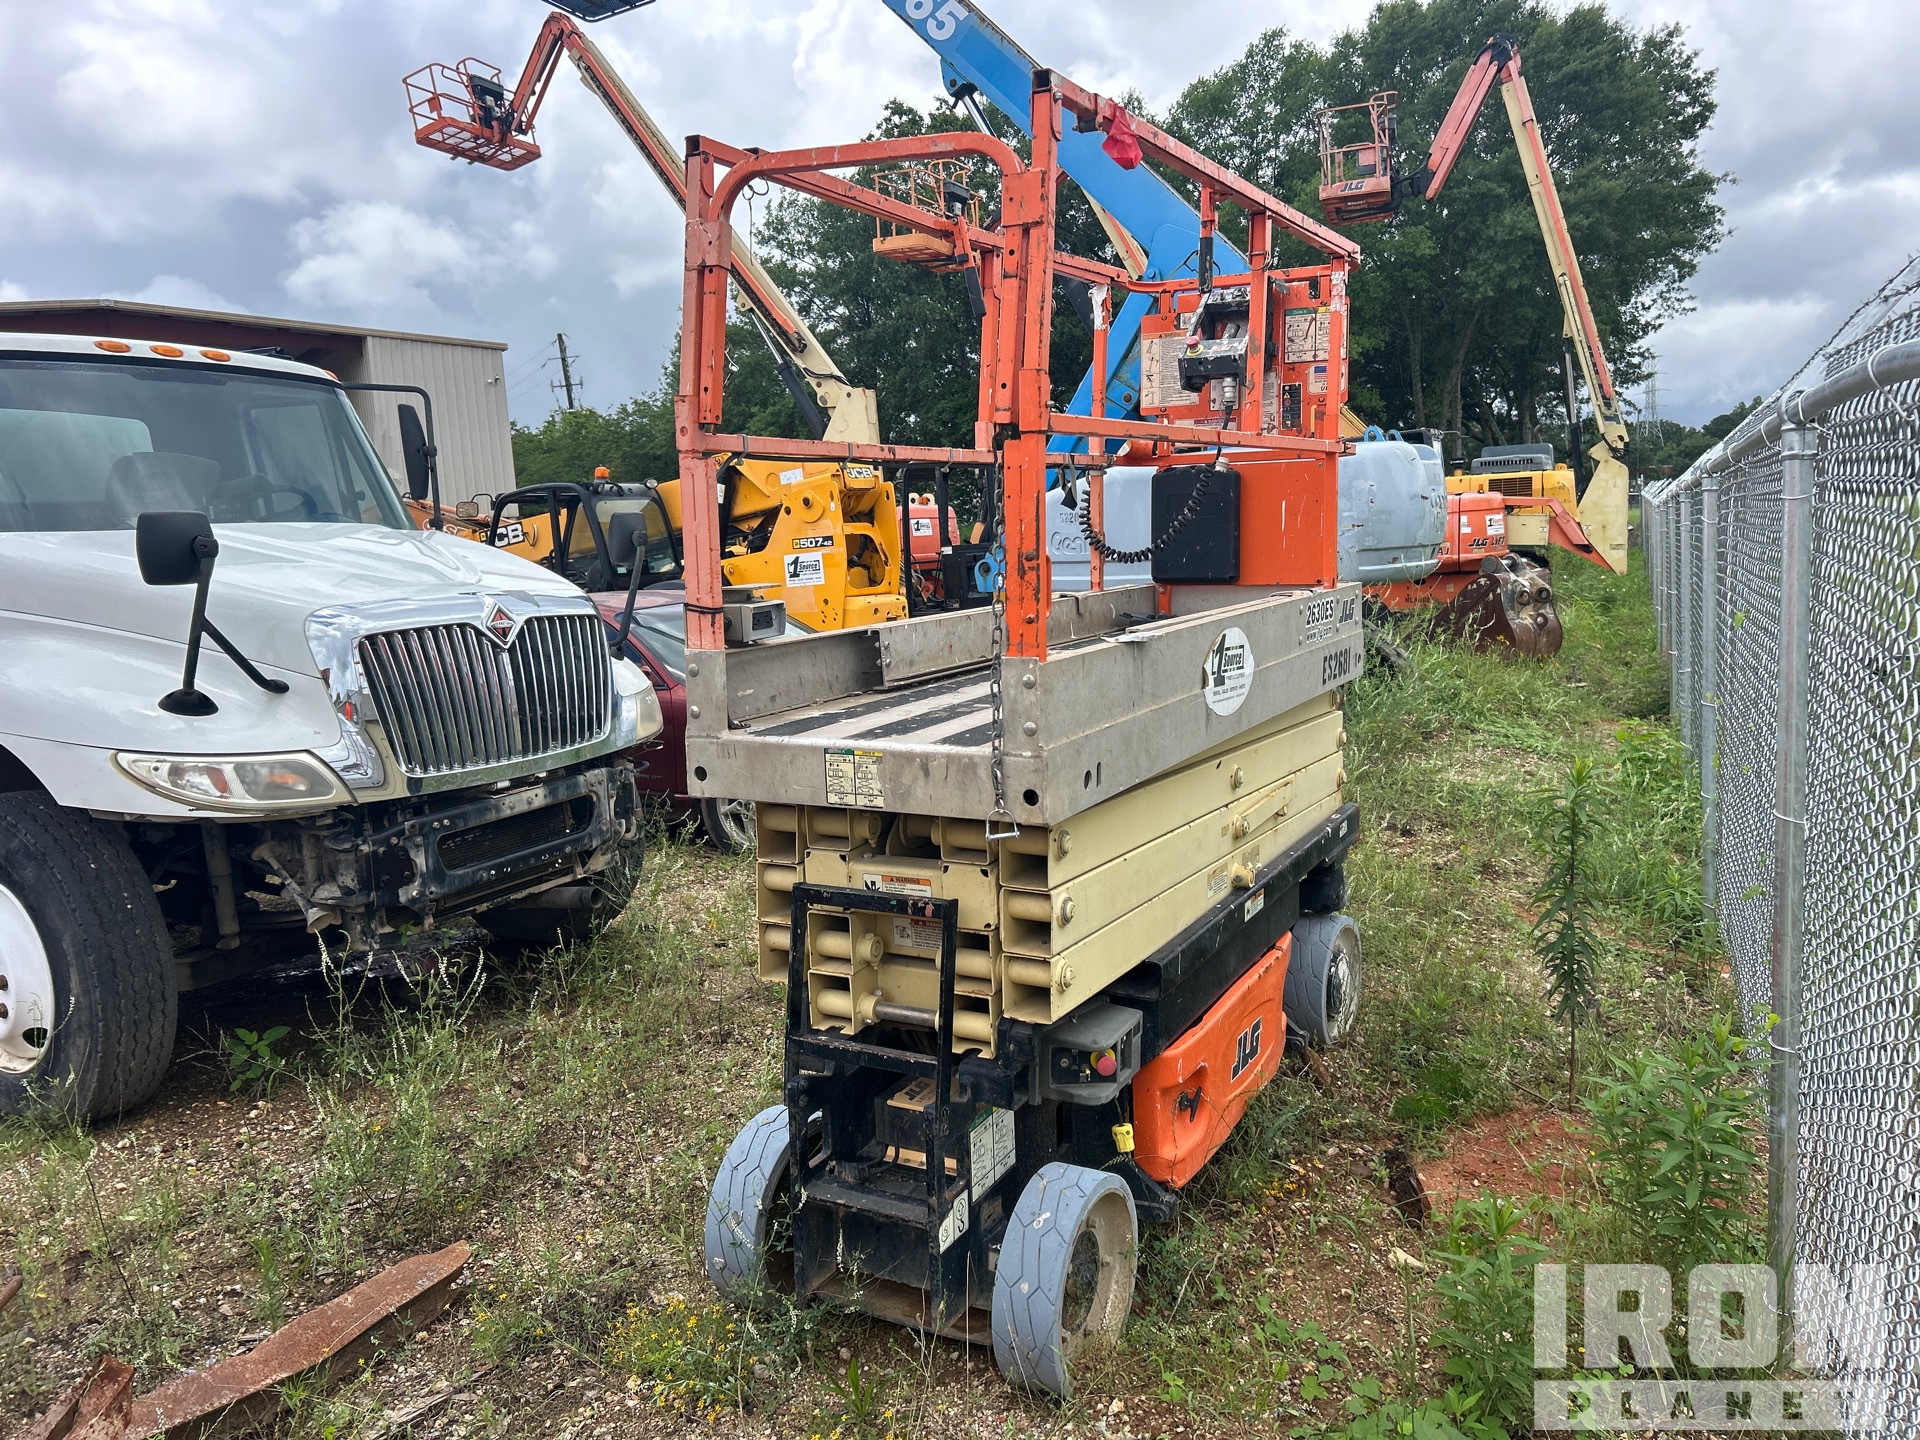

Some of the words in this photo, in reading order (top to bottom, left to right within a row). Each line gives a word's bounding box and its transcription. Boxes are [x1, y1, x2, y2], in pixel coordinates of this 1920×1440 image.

[1339, 180, 1366, 194] JLG
[848, 467, 873, 478] JCB
[487, 523, 525, 547] CB
[1468, 537, 1489, 548] JLG
[789, 556, 800, 579] 1
[799, 563, 818, 571] Source
[1306, 597, 1335, 628] 2630ES
[1339, 597, 1356, 624] JLG
[1213, 633, 1226, 688] 1
[1223, 652, 1242, 668] Source
[896, 877, 920, 885] WARNING
[1231, 1015, 1262, 1083] JLG
[904, 1080, 931, 1101] JLG
